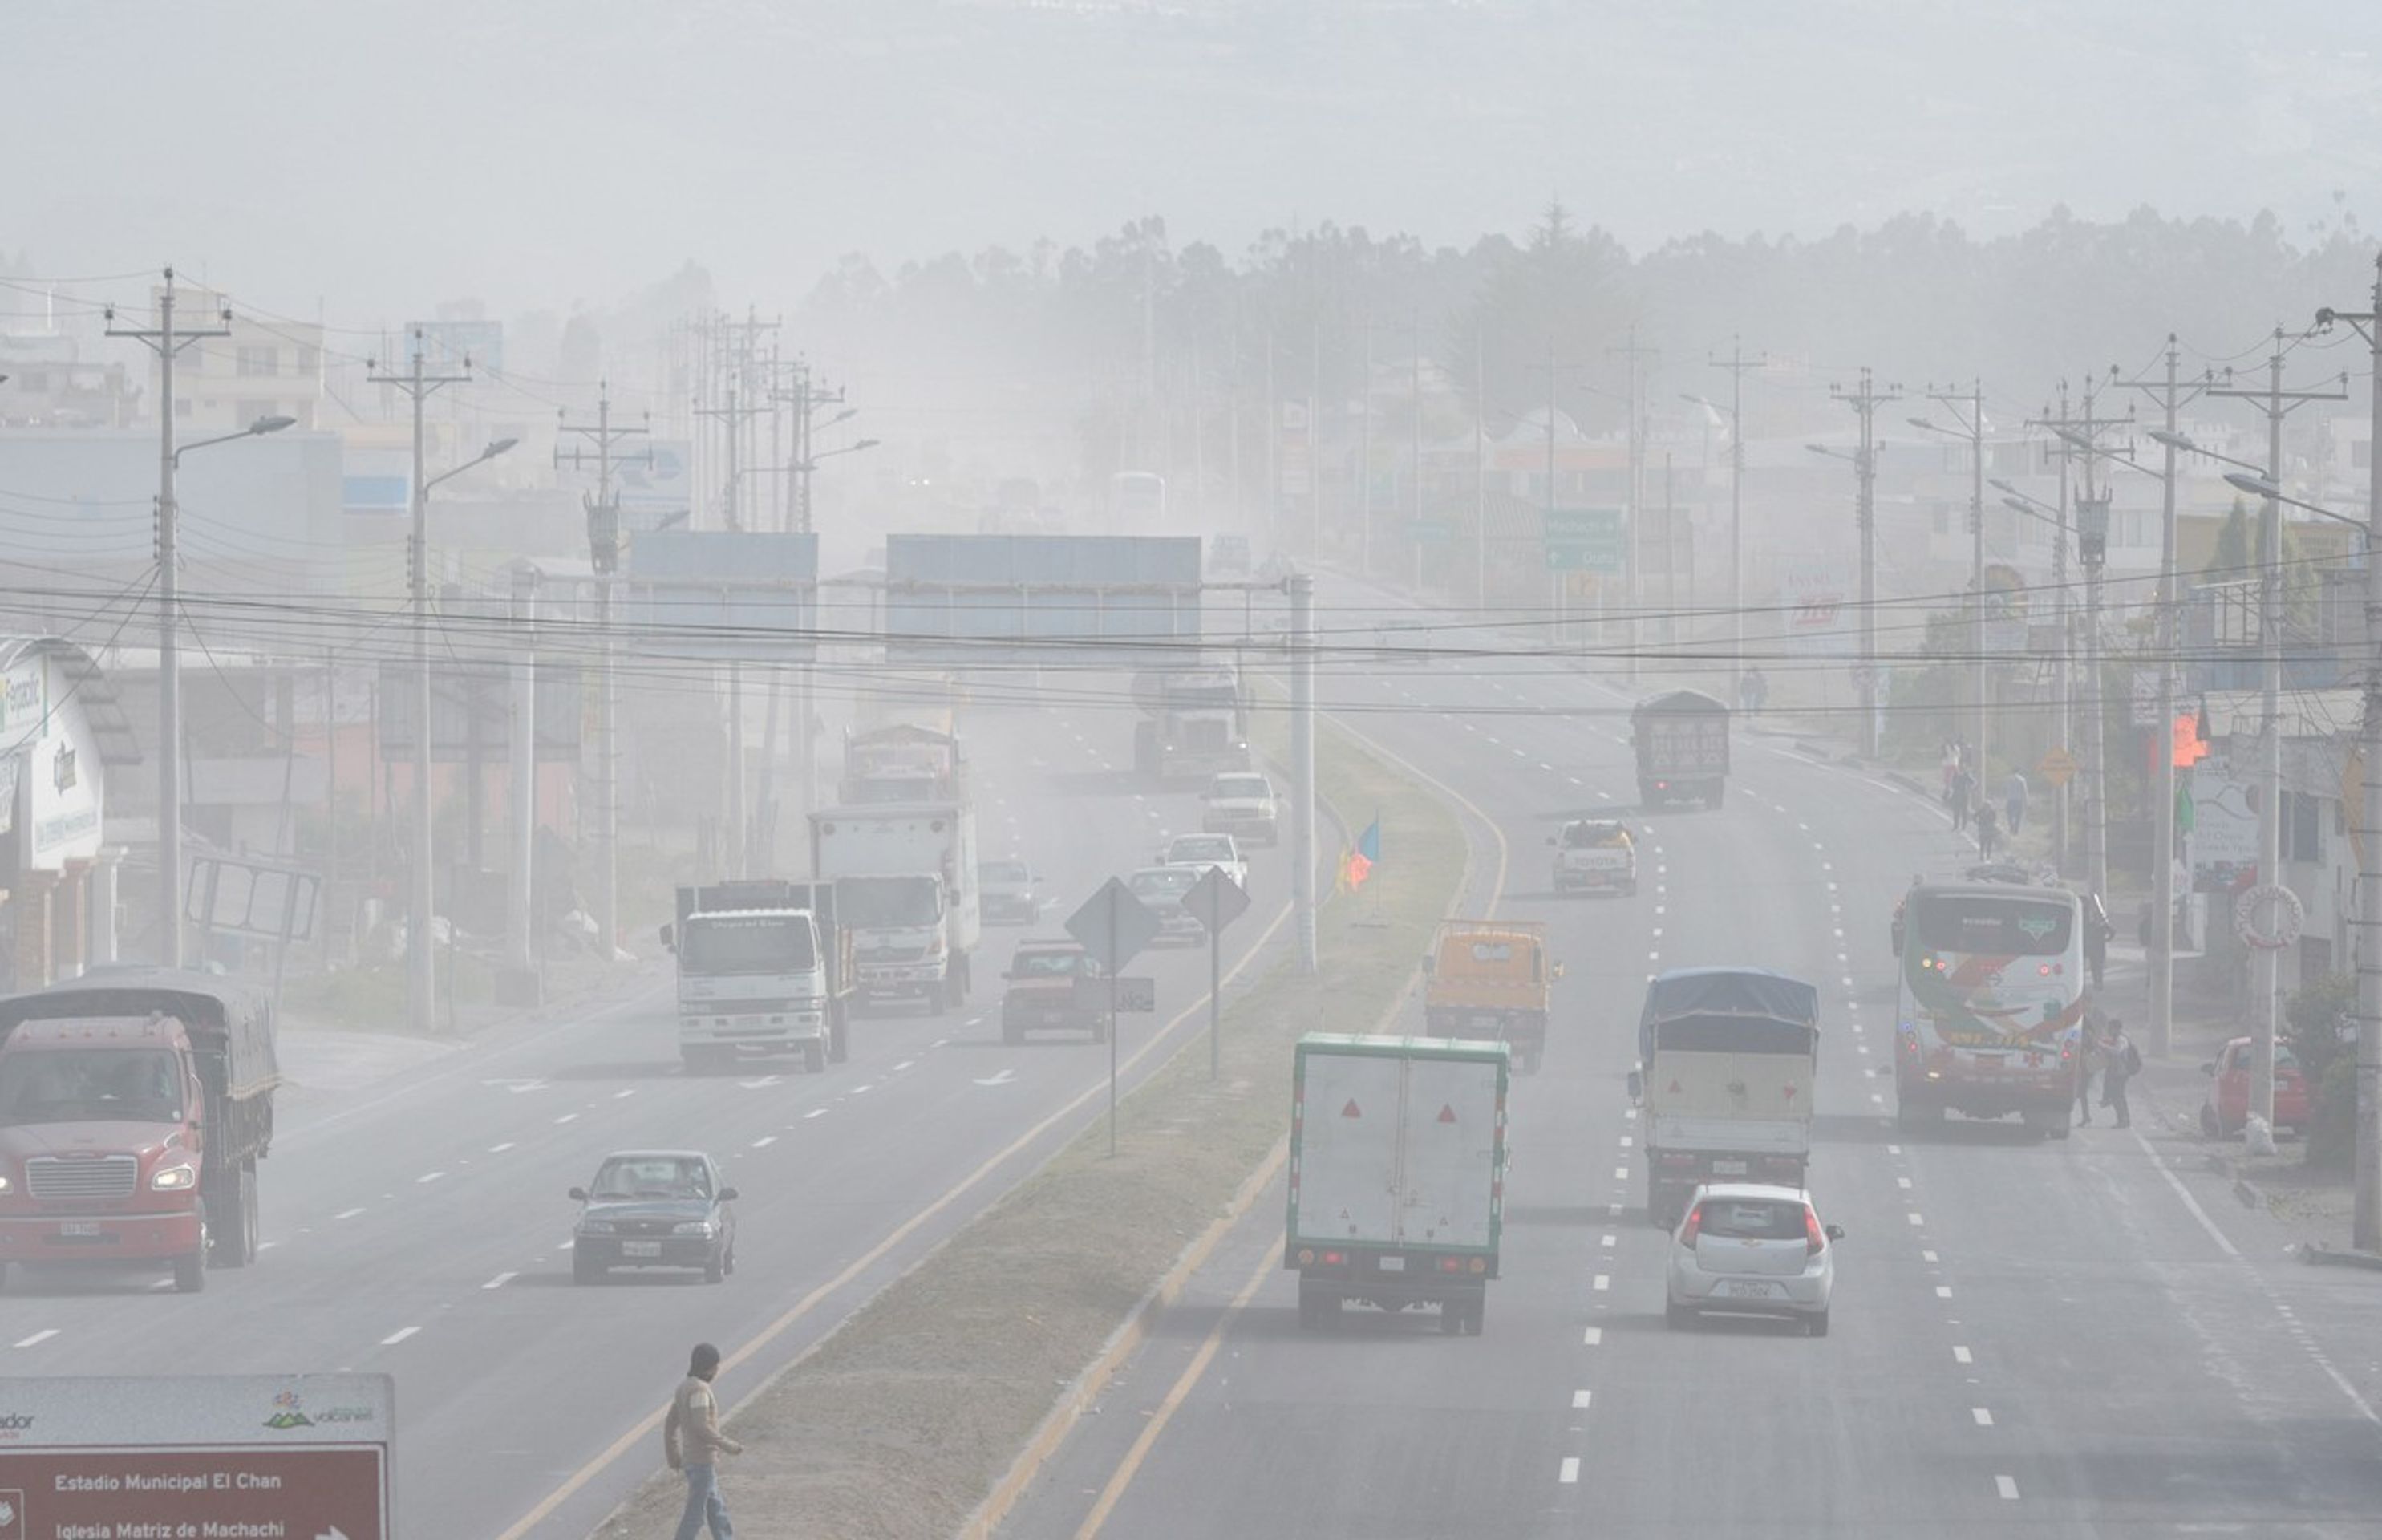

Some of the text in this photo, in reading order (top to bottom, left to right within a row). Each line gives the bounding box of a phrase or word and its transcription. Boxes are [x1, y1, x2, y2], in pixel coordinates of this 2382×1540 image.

[1574, 857, 1618, 867] TOYOTA
[55, 1473, 281, 1494] Estadio Municipal El Chan
[56, 1521, 285, 1540] Iglesia Matriz de Machachi
